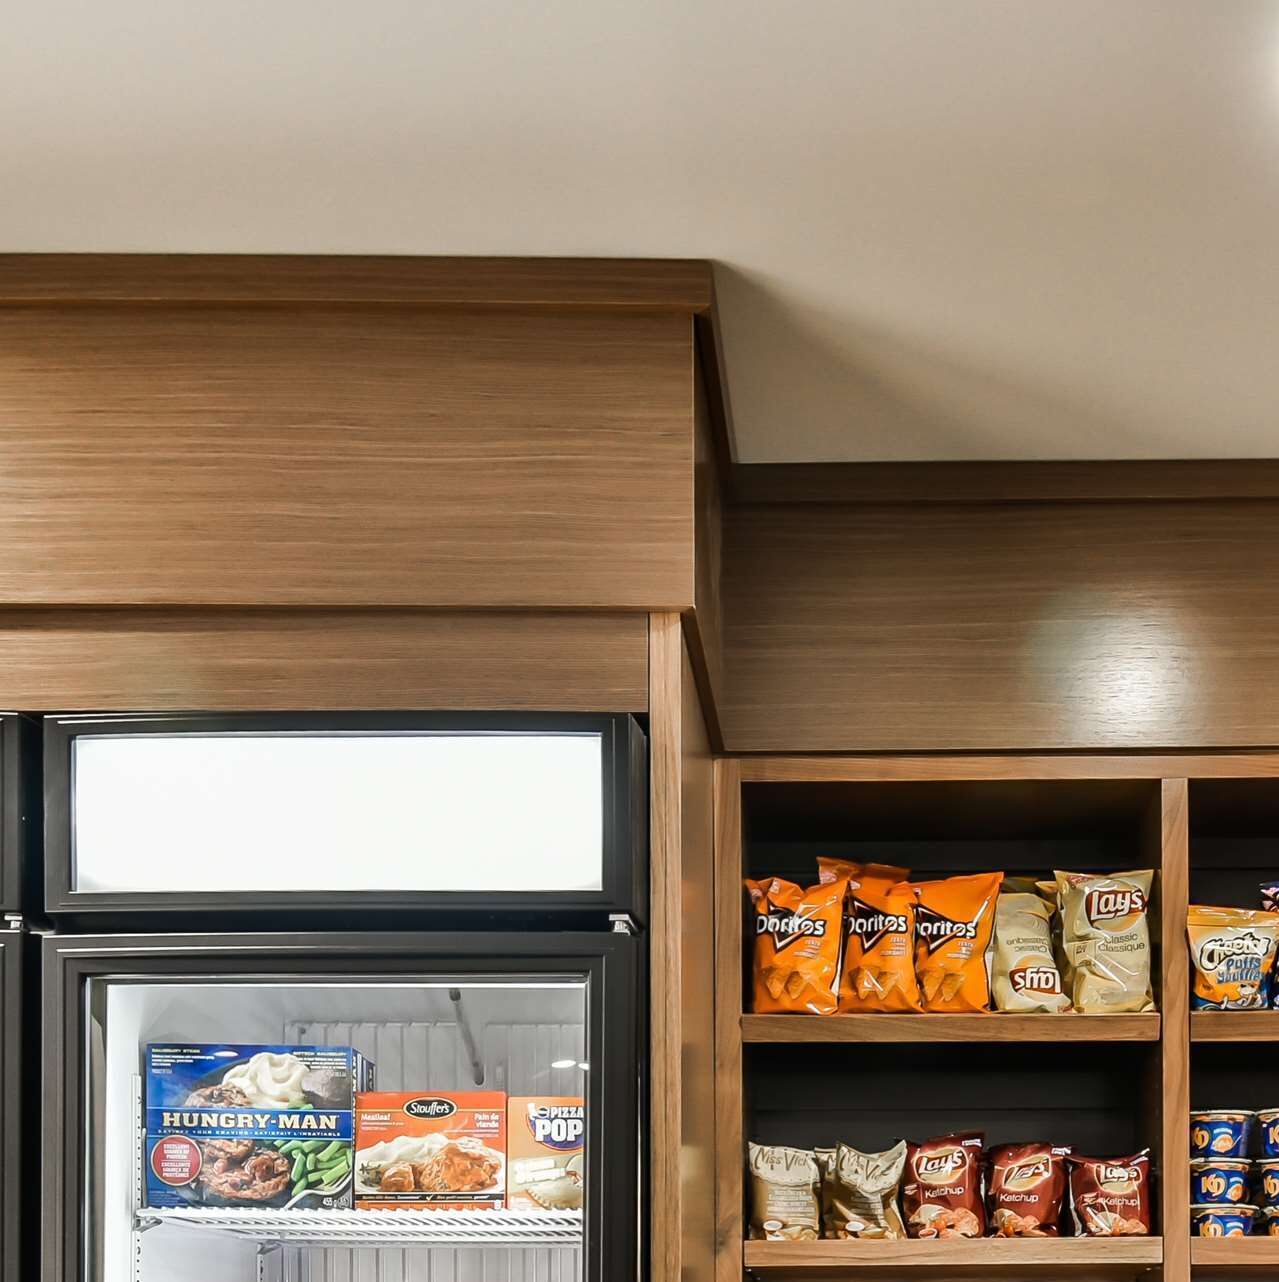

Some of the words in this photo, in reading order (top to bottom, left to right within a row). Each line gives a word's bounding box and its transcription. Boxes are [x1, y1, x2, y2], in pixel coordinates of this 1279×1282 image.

[756, 915, 826, 935] Doritos
[915, 921, 977, 938] oritos
[550, 1106, 584, 1118] PIZZA
[161, 1111, 339, 1130] HUNGRY-MAN
[924, 1185, 965, 1199] Ketchup
[999, 1192, 1039, 1203] Ketchup
[1102, 1195, 1139, 1206] Ketchup
